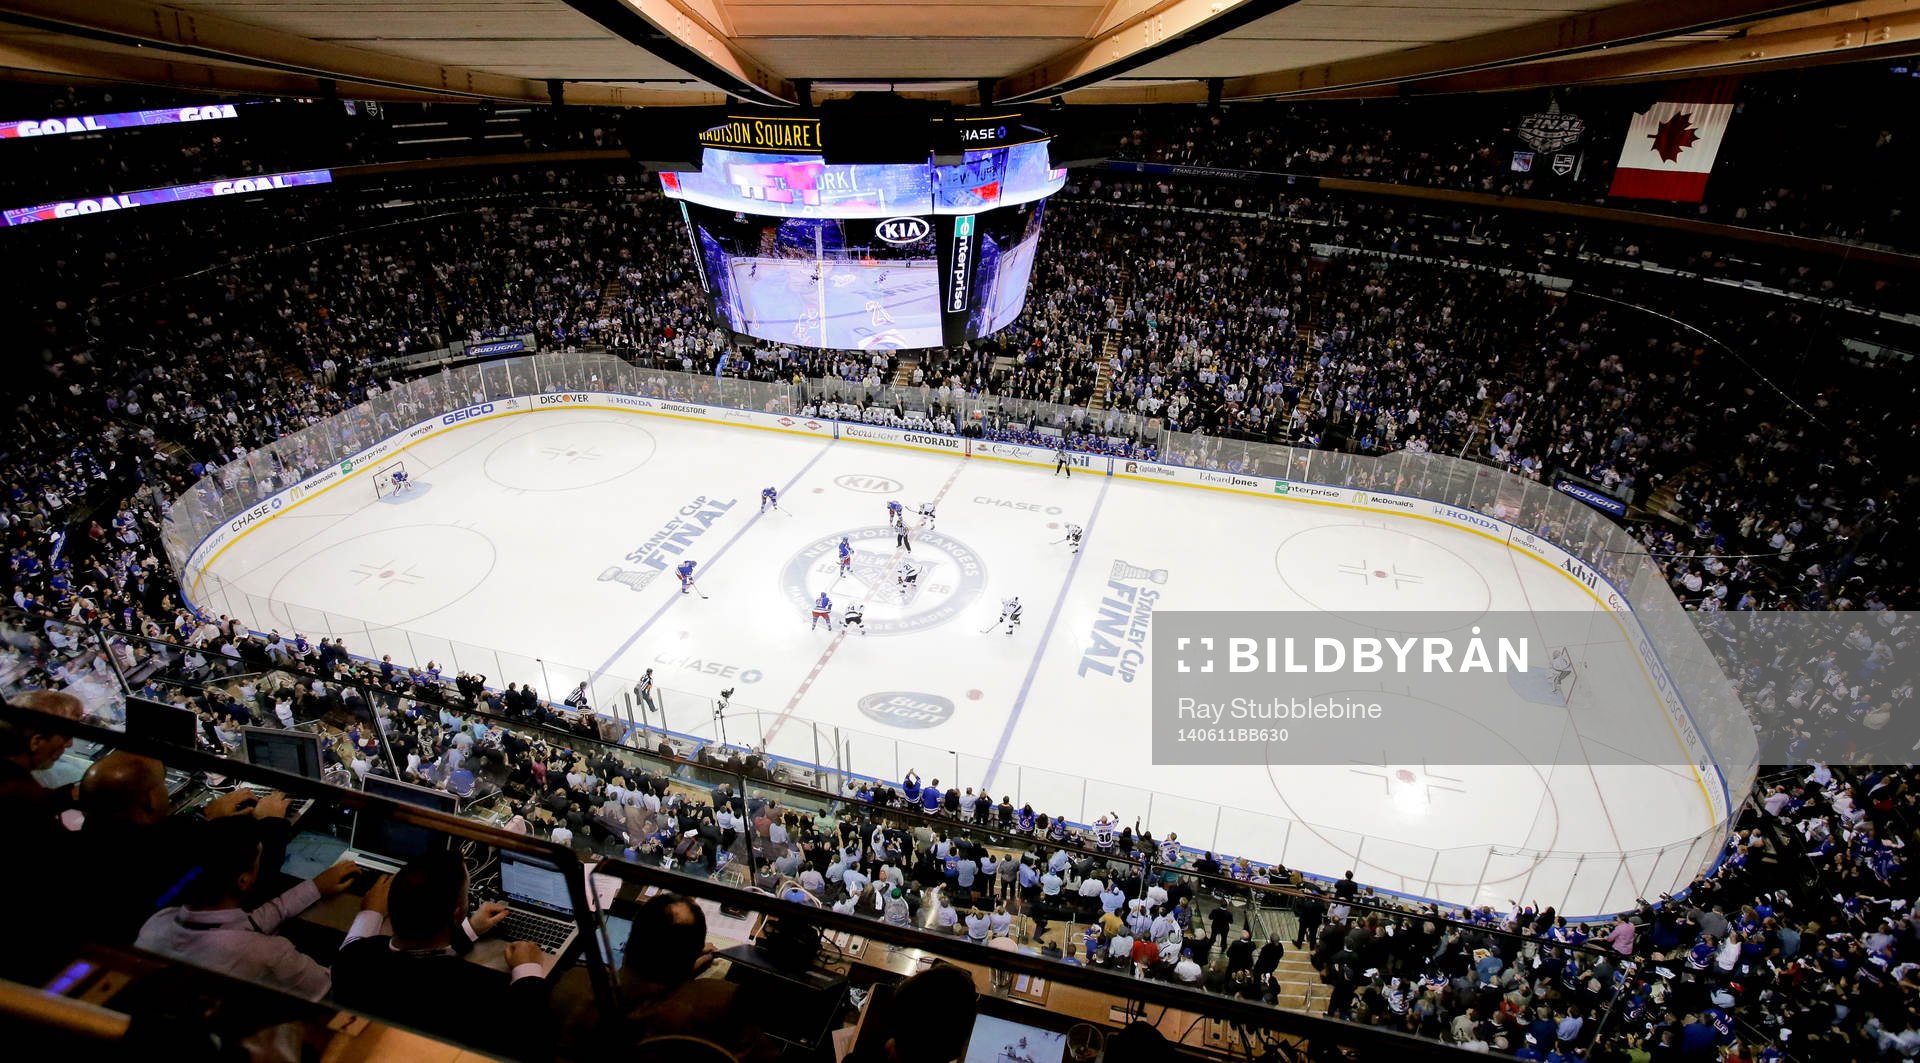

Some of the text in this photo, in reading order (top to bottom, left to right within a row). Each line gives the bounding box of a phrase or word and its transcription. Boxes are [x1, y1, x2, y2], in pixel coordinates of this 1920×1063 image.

[17, 116, 107, 137] GOAL
[755, 120, 811, 147] SQUARE
[1521, 117, 1584, 132] FINAL
[213, 175, 292, 195] GOAL
[54, 195, 140, 218] GOAL
[884, 221, 921, 239] KIA
[953, 220, 970, 310] enterprise
[494, 343, 519, 352] LIGHT
[540, 393, 589, 405] DISCOVER
[614, 397, 652, 408] HONDA
[660, 402, 707, 415] BRIDGESTONE
[442, 403, 495, 426] GEICO
[409, 424, 434, 438] verizon
[903, 433, 959, 449] GATORADE
[343, 445, 388, 472] enterprise
[304, 471, 337, 490] McDonald's
[849, 476, 890, 492] KIA
[1200, 472, 1258, 488] Edward Jones
[1276, 483, 1341, 498] enterprise
[973, 495, 1040, 512] CHASE
[1370, 496, 1414, 508] McDonald's
[1562, 484, 1621, 510] BUD LIGHT
[231, 503, 271, 533] CHASE
[1446, 509, 1500, 533] HONDA
[625, 495, 707, 564] STANLEY CUP
[642, 498, 738, 571] FINAL
[919, 533, 980, 577] RANGERS
[1560, 558, 1598, 590] Advil
[1077, 579, 1138, 679] FINAL
[1118, 586, 1160, 683] STANLEY CUP
[654, 653, 740, 679] CHASE
[1639, 638, 1666, 692] GEICO
[875, 702, 947, 724] LIGHT
[889, 695, 944, 714] BUD
[1665, 690, 1697, 749] DISCOVER
